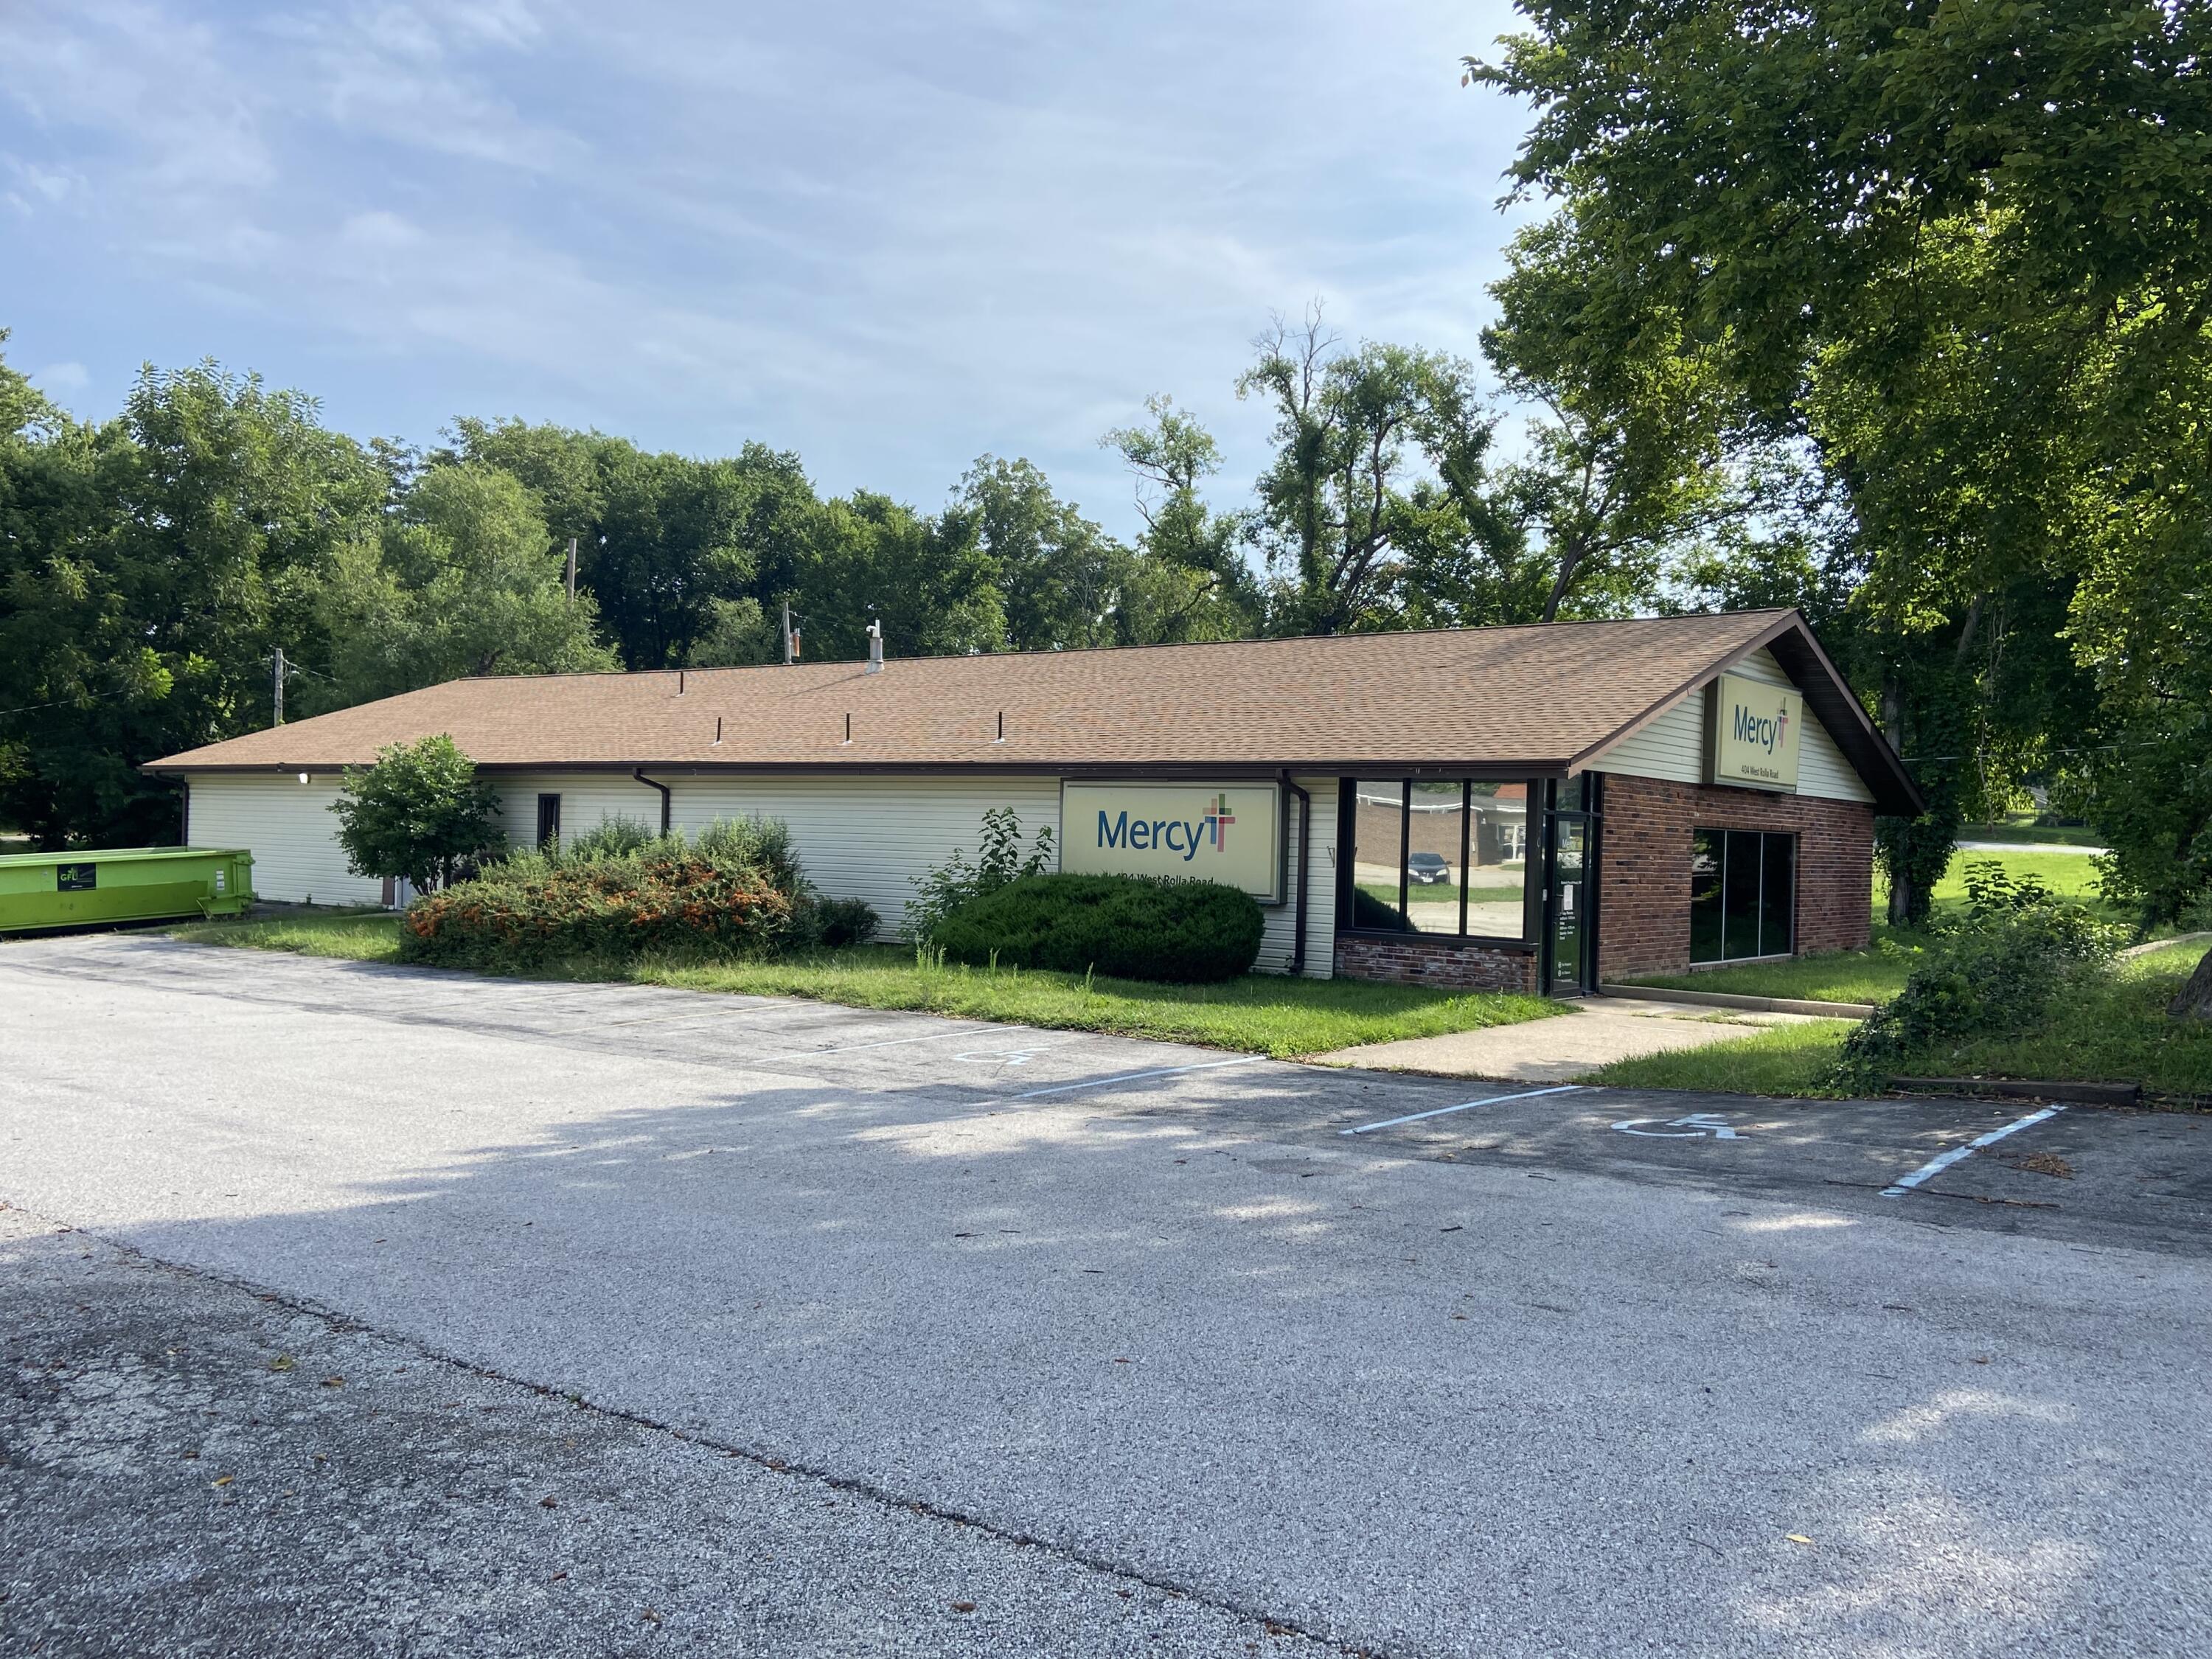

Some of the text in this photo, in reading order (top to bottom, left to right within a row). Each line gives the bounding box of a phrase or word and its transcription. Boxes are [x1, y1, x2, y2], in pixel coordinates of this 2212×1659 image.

[1734, 704, 1777, 755] Mercy
[1741, 765, 1749, 774] 404
[1750, 766, 1759, 776] West
[1770, 768, 1778, 779] Road
[1097, 810, 1205, 861] Mercy
[60, 873, 77, 881] GFL
[1138, 874, 1162, 886] West
[1164, 874, 1186, 886] Rolla
[1189, 876, 1214, 885] Road
